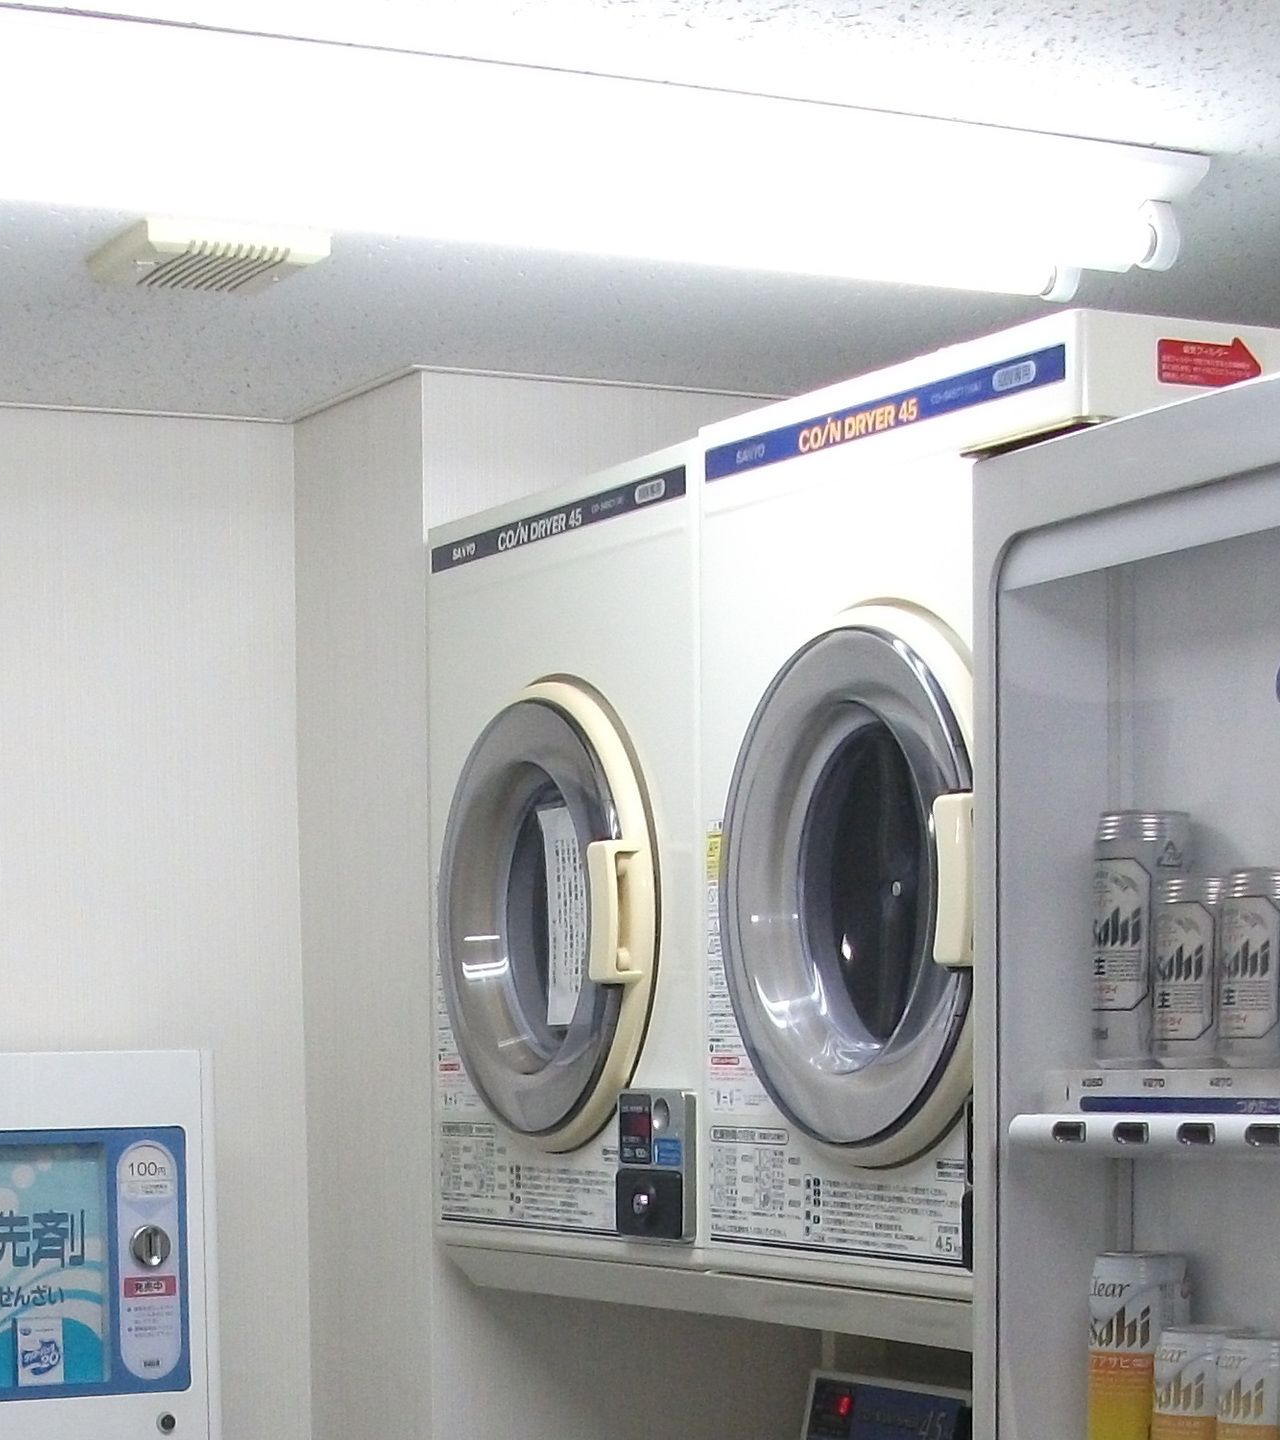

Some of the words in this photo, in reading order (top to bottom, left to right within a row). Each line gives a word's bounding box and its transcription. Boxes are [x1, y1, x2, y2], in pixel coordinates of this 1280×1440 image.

[845, 405, 895, 437] DRYER
[899, 398, 918, 423] 45
[530, 512, 565, 540] DRYER
[569, 507, 582, 529] 45
[1093, 1277, 1130, 1298] lear
